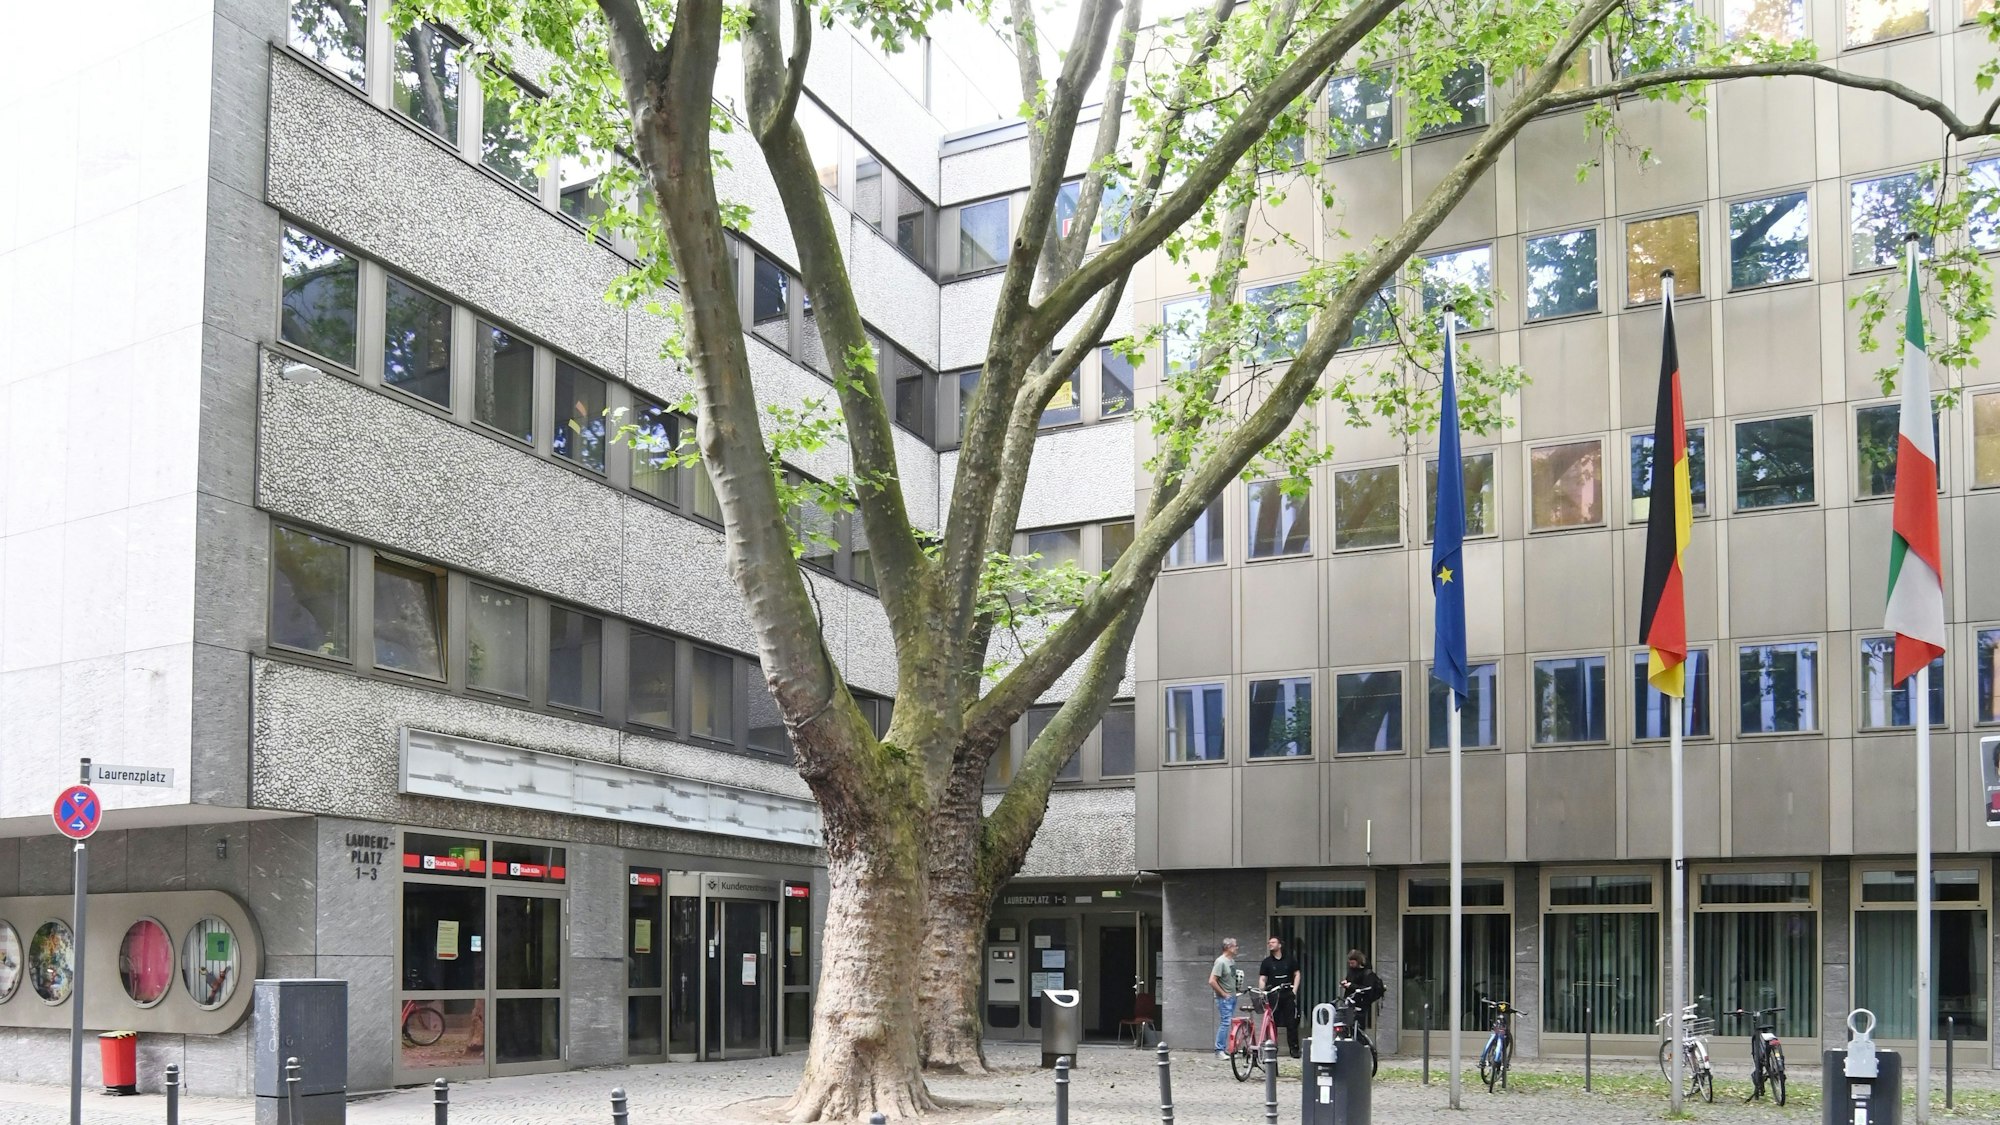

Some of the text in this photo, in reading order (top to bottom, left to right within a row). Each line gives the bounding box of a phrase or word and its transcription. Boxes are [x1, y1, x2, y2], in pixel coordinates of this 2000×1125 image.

[98, 767, 166, 784] Laurenzplatz
[345, 833, 395, 849] LAURENZ-
[351, 850, 382, 865] PLATZ
[1003, 896, 1050, 905] LAURENZPLATZ
